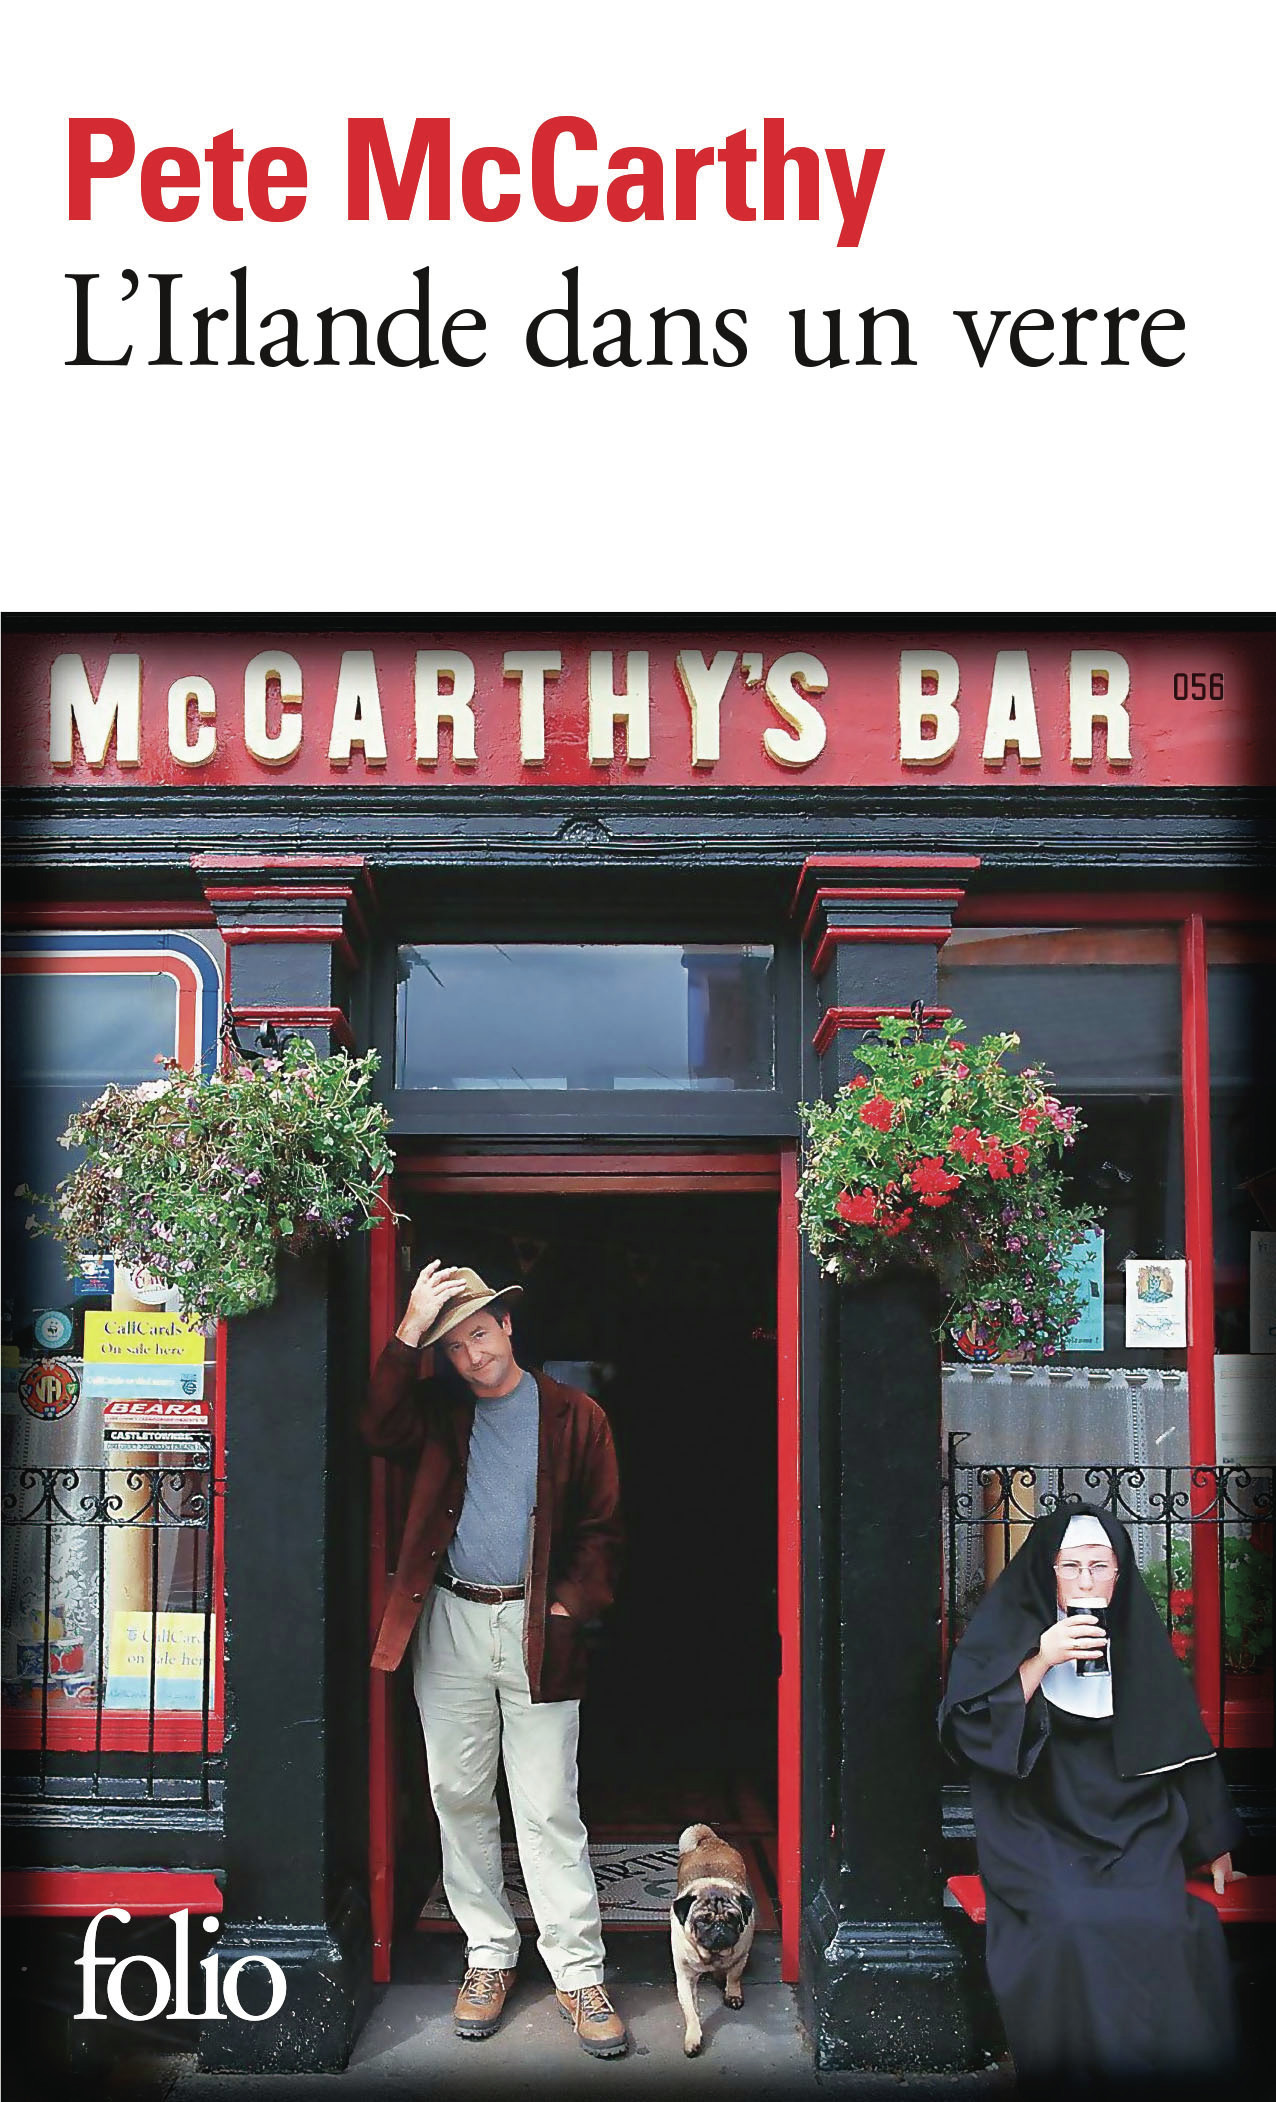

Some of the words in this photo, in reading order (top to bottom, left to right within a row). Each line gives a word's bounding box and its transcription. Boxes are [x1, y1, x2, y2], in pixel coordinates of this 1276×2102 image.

[49, 650, 829, 768] McCARTHY’S
[899, 650, 1132, 767] BAR
[104, 1321, 182, 1336] CallCards
[101, 1343, 121, 1354] On
[127, 1343, 150, 1354] sale
[156, 1343, 184, 1355] here
[110, 1403, 202, 1415] BEARA
